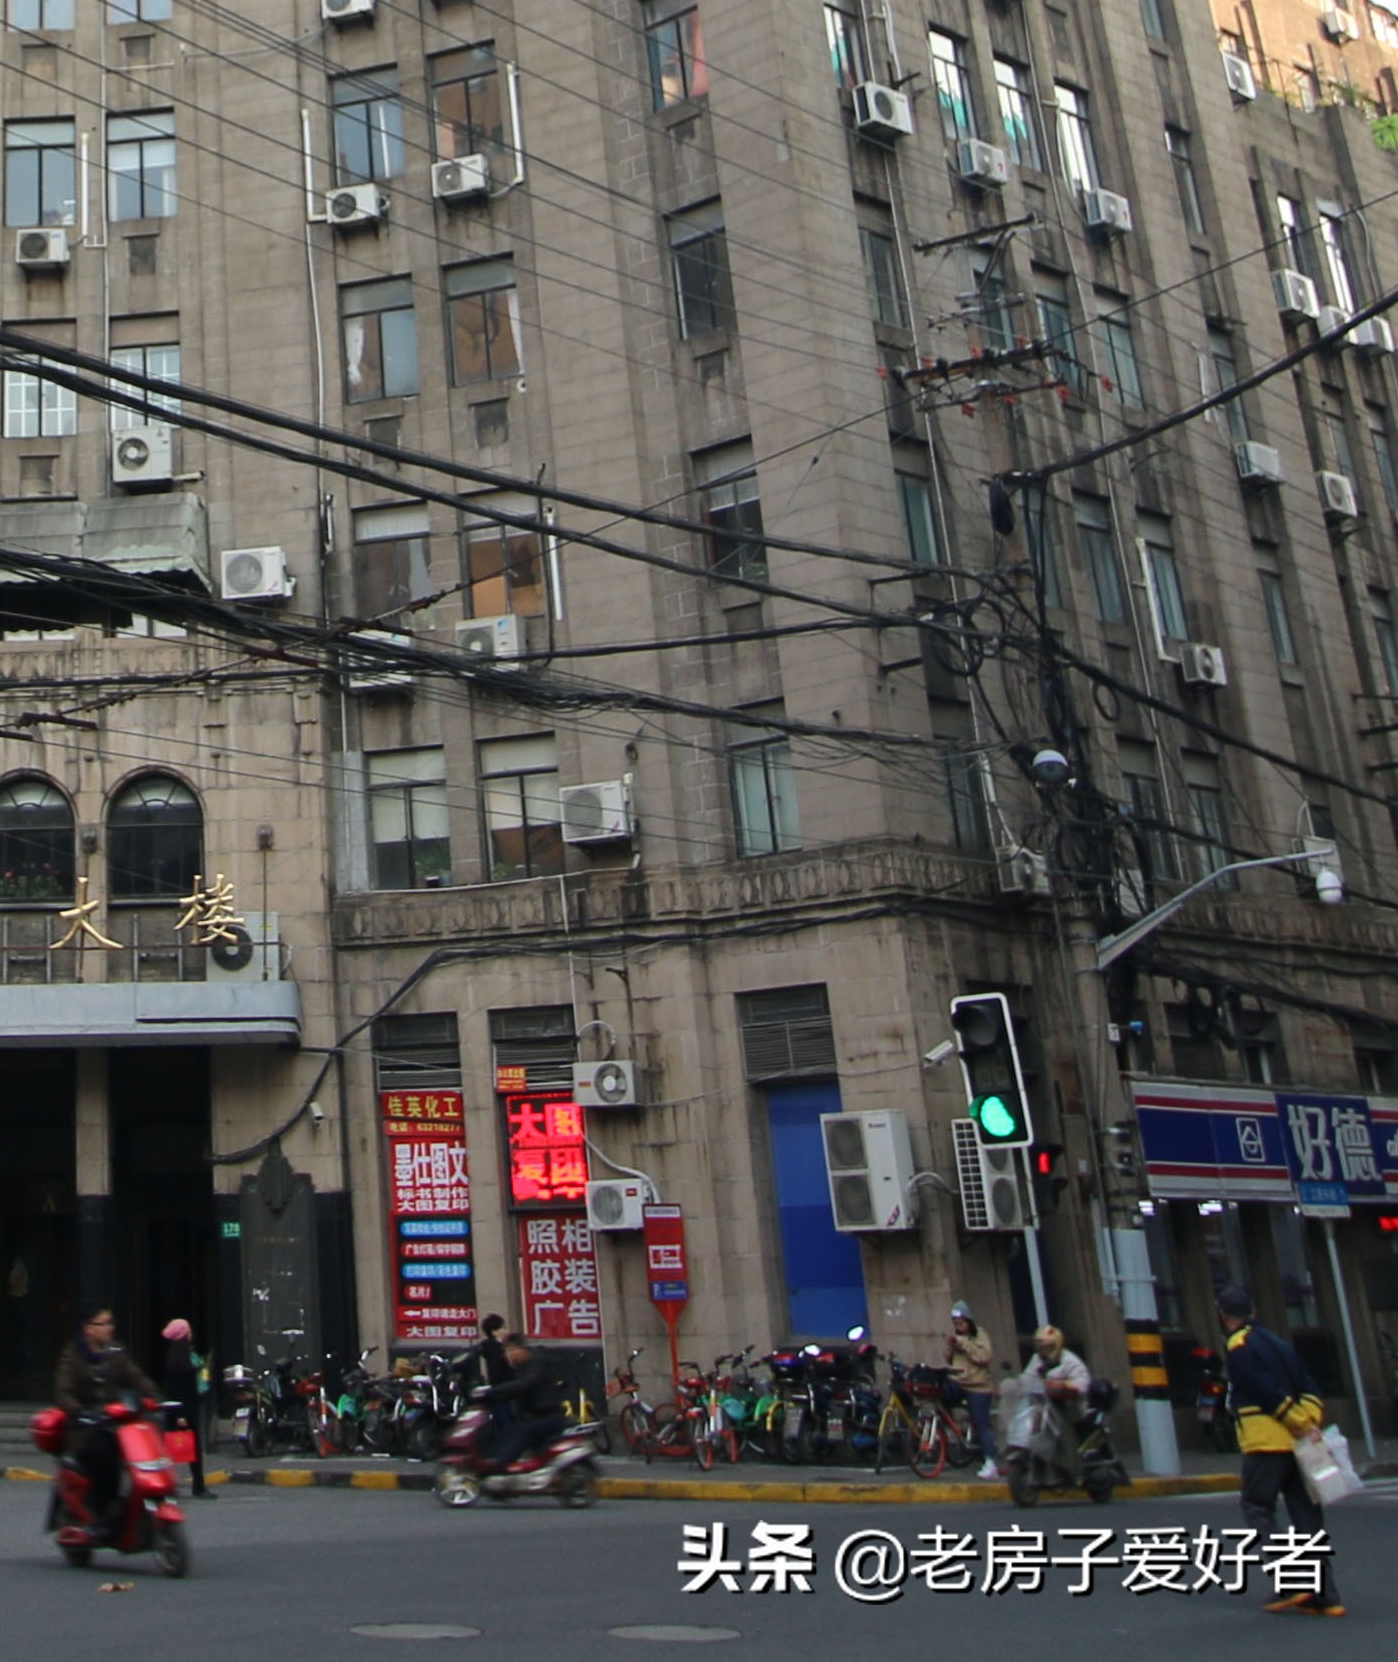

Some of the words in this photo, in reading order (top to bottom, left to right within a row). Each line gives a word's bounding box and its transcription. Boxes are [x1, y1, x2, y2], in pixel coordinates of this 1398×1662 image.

[388, 1096, 459, 1118] 佳英化工
[1287, 1104, 1383, 1180] 好德
[395, 1141, 469, 1187] 墨仕图文
[397, 1187, 469, 1199] 标书制作
[397, 1199, 470, 1211] 大图复印
[527, 1219, 592, 1254] 照相
[530, 1259, 596, 1294] 胶装
[406, 1326, 477, 1337] 大图复印
[534, 1300, 599, 1335] 广告
